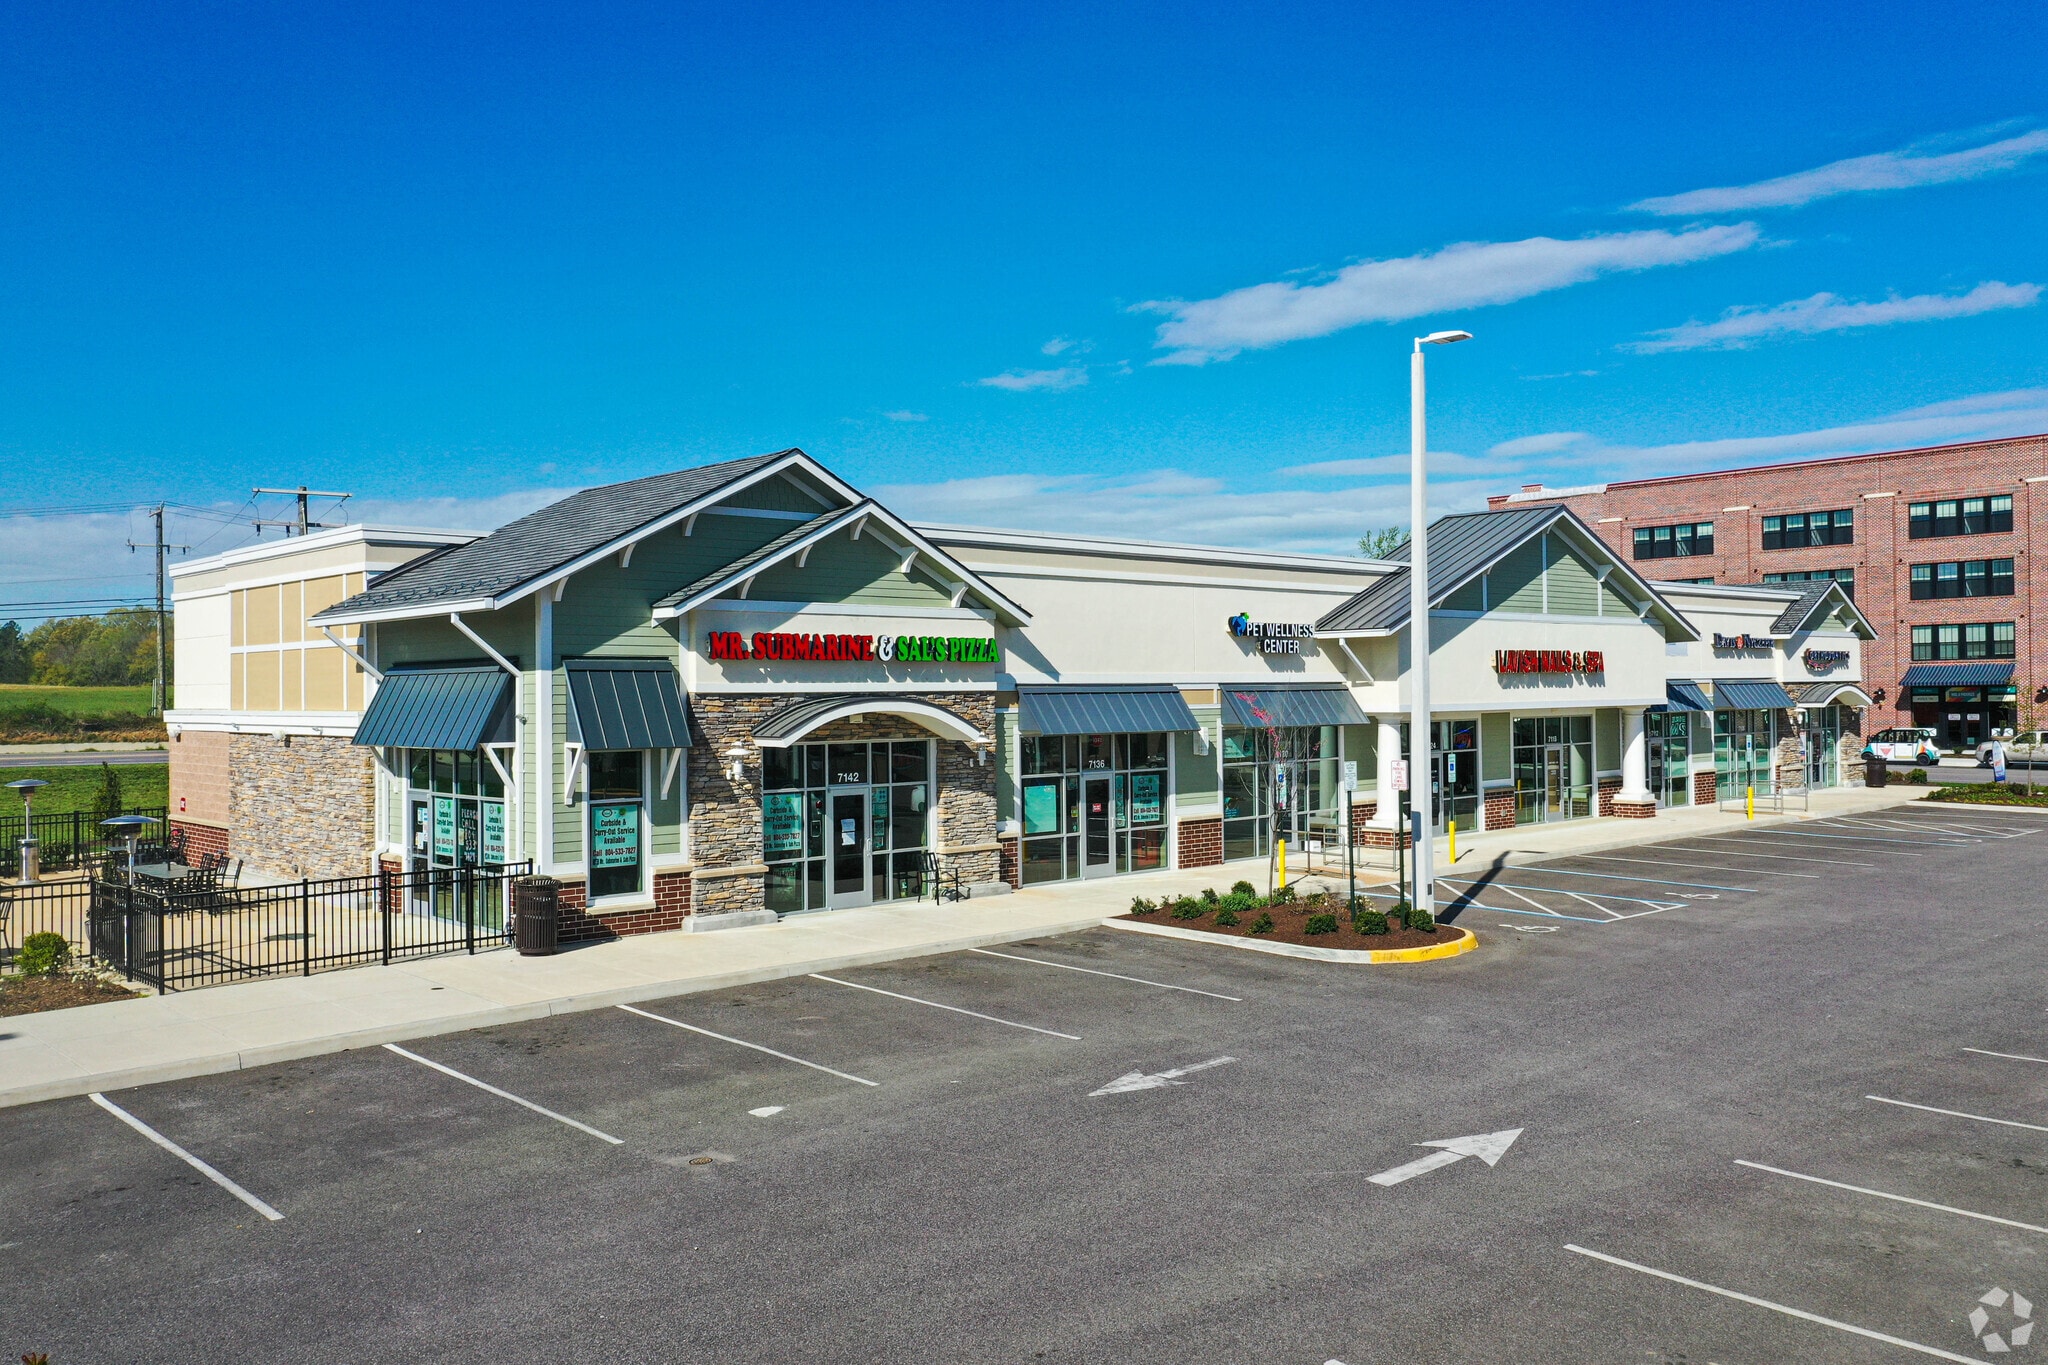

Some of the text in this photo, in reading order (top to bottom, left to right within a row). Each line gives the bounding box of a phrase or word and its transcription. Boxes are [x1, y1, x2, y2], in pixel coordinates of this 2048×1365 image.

[1246, 622, 1315, 638] PET WELLNESS
[708, 631, 1000, 662] MR. SUBMARINE & SAL'S PIZZA
[1263, 638, 1300, 654] CENTER
[1496, 650, 1538, 673] LAVISH
[1540, 650, 1572, 673] NAILS
[1583, 650, 1605, 674] SPA
[1088, 759, 1105, 769] 7136
[837, 772, 859, 783] 7142
[600, 819, 621, 827] Curbside
[594, 827, 635, 836] Carry-Out Service
[603, 835, 626, 844] Available
